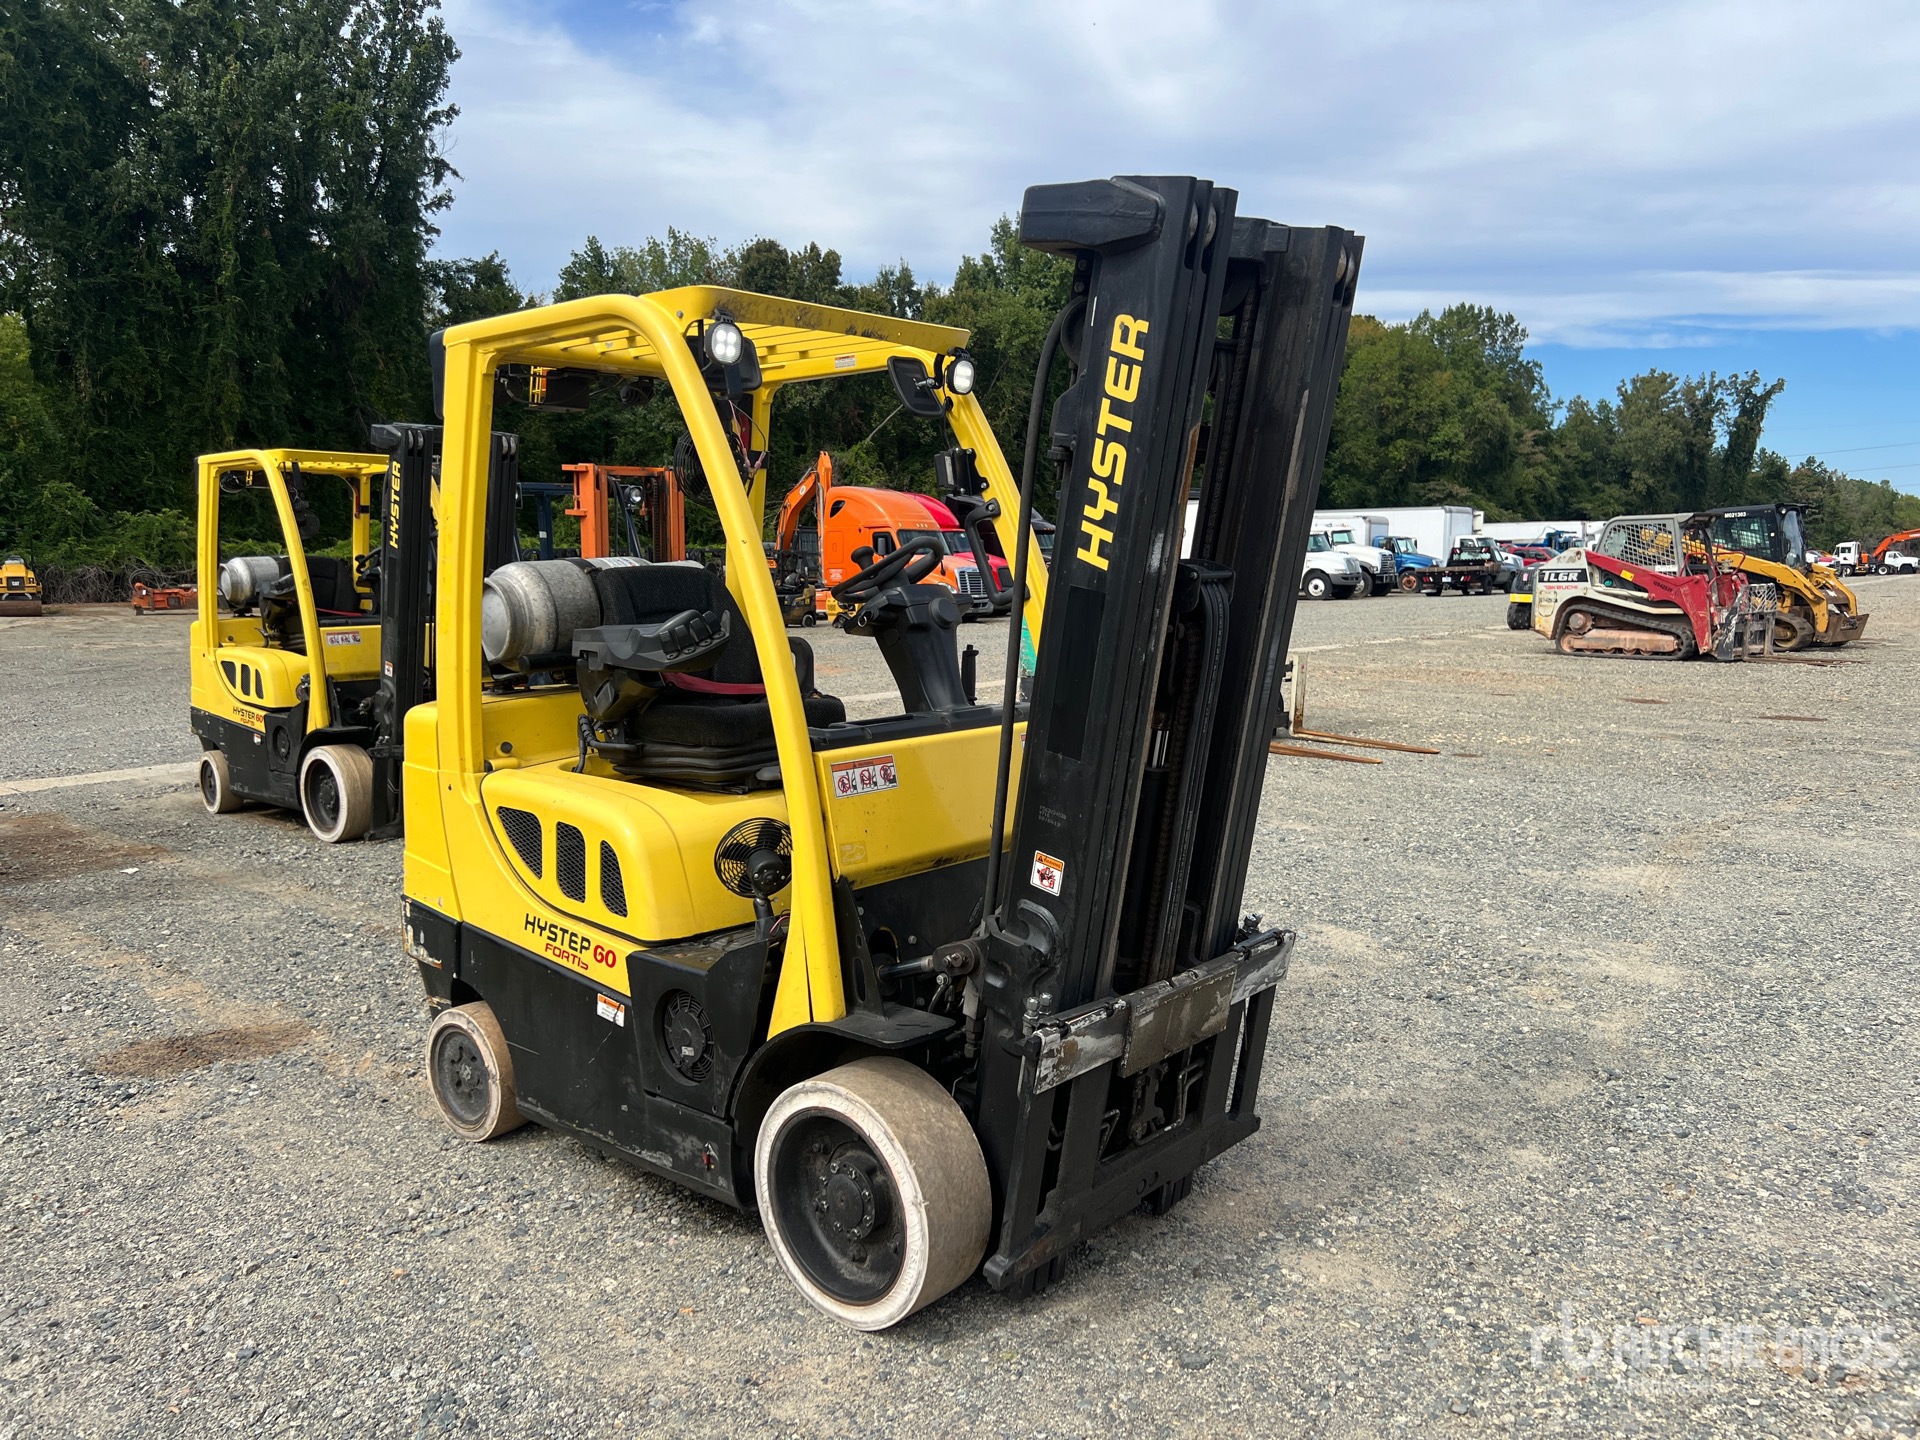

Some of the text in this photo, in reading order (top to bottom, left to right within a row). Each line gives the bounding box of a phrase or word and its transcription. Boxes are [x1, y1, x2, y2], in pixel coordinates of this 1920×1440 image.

[1076, 313, 1150, 572] HYSTER
[390, 461, 401, 549] HYSTER
[233, 706, 263, 723] HYSTER 60
[544, 942, 589, 971] FORTIS
[593, 945, 617, 969] 60
